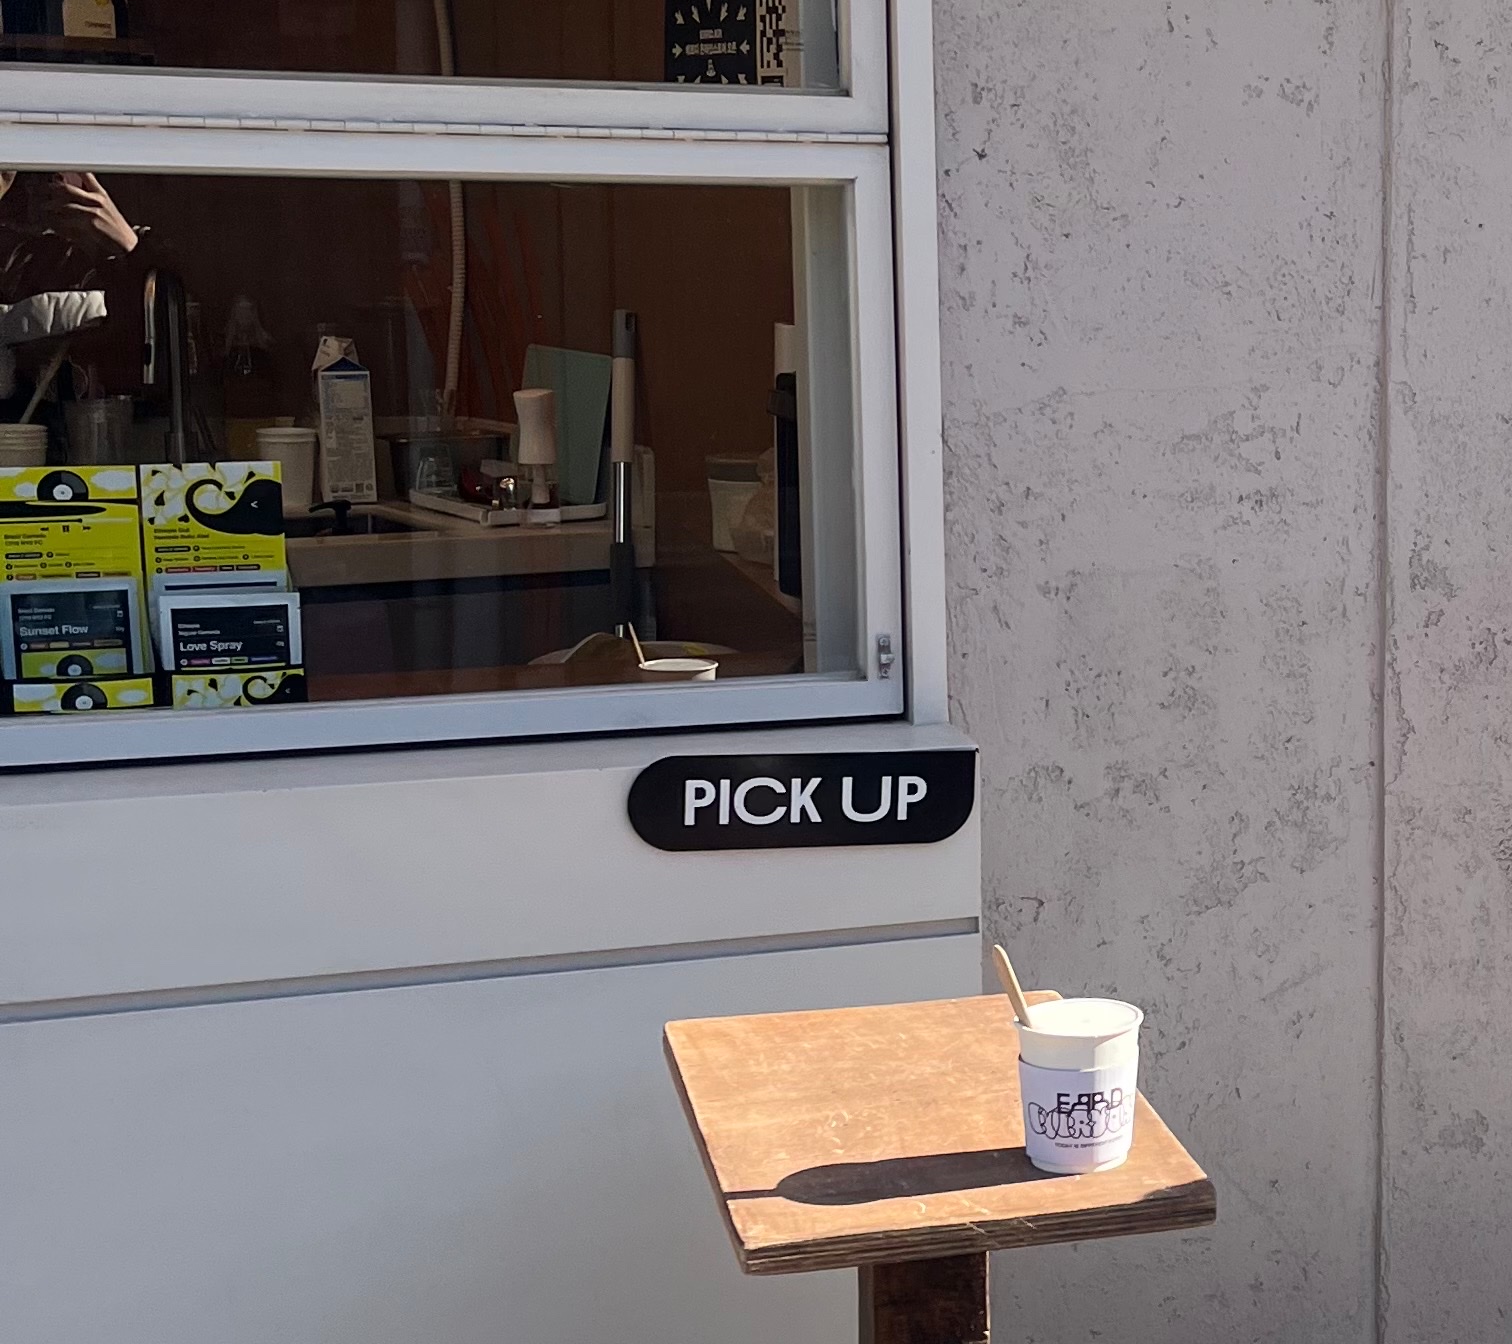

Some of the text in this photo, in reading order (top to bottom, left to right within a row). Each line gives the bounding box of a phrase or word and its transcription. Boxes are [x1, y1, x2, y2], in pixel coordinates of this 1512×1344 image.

[19, 624, 89, 637] Sunset Flow
[179, 640, 243, 653] Love Spray
[684, 775, 928, 826] PICK UP
